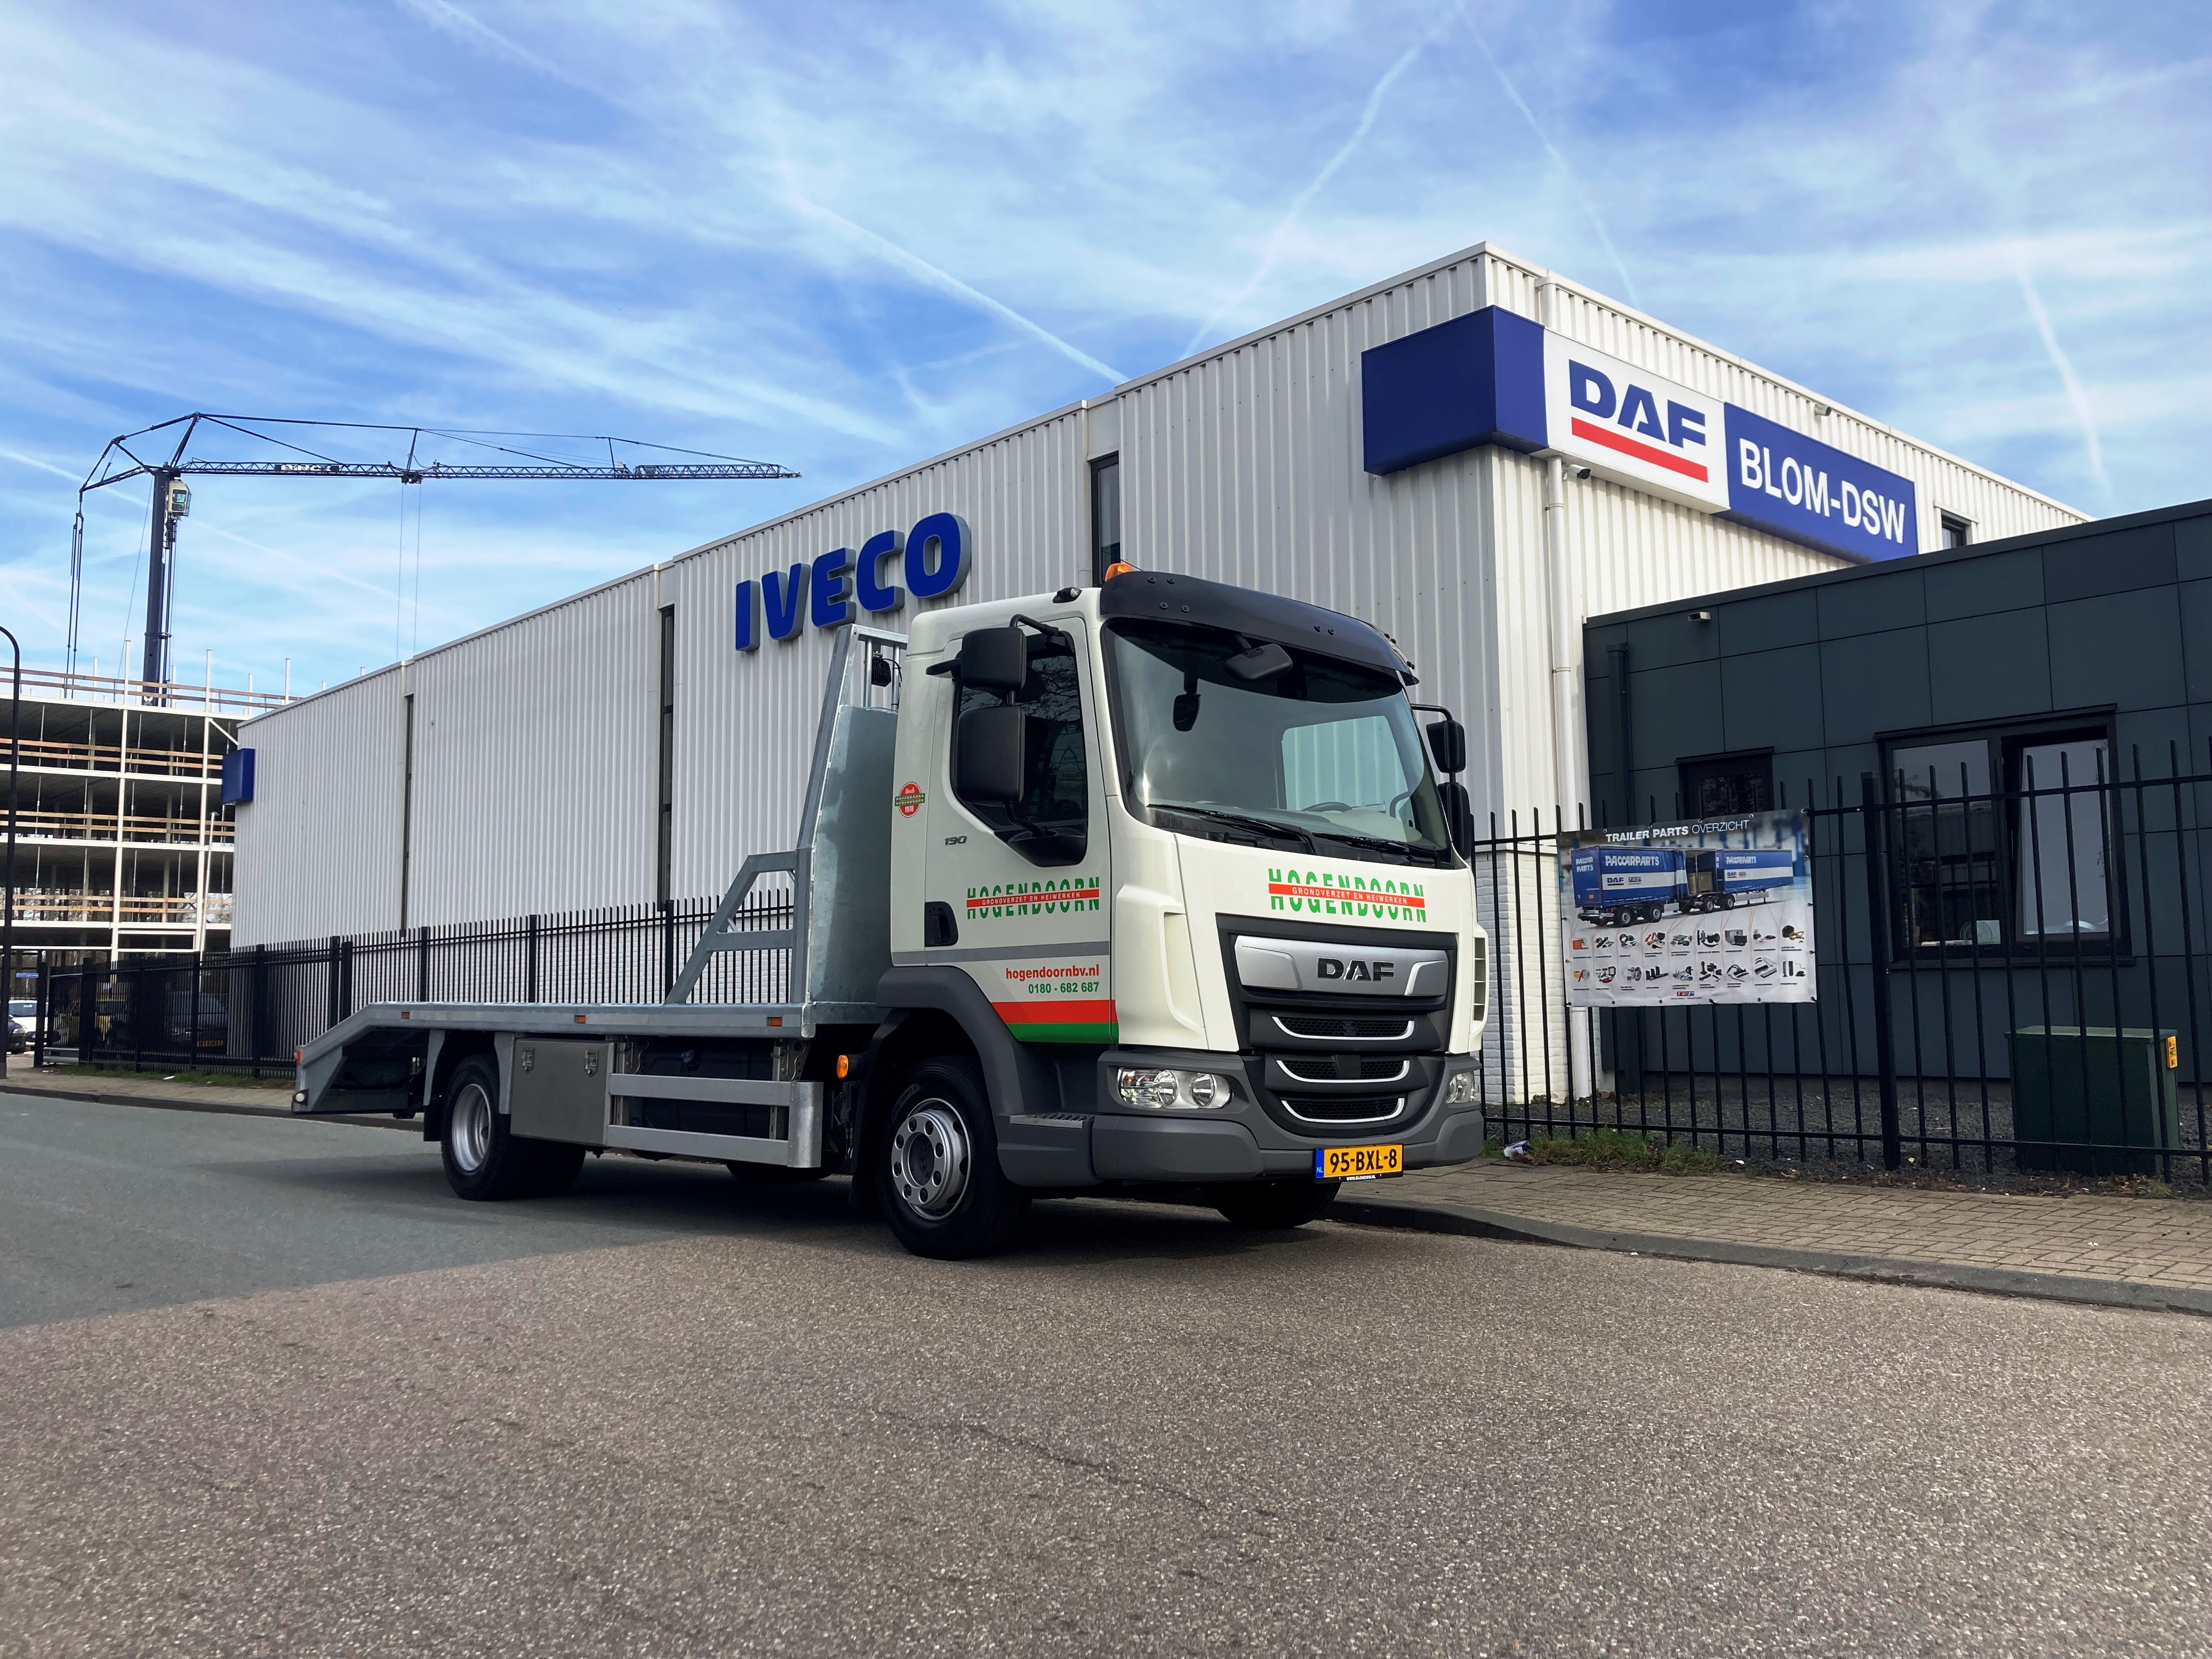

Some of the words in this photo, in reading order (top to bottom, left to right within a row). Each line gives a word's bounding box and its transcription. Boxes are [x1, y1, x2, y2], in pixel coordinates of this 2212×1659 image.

[1569, 359, 1706, 448] DAF
[1740, 438, 1905, 544] BLOM-DSW
[736, 512, 971, 651] IVECO
[945, 836, 968, 845] 190
[1606, 830, 1650, 843] TRAILER
[1652, 826, 1689, 838] PARTS
[1691, 820, 1750, 834] OVERZICHT
[1576, 864, 1594, 873] PARTS
[967, 877, 1099, 919] HOGENDOORN
[982, 896, 1027, 905] GRONDVERZET
[1041, 886, 1081, 900] HEIWERKEN
[1268, 868, 1426, 922] HOGENDOORN
[1292, 887, 1350, 900] GRONDVERZET
[1366, 894, 1407, 905] HEIWERKEN
[1006, 964, 1099, 981] hogendoornbv.nl
[1318, 957, 1394, 981] DAF
[1028, 983, 1051, 994] 0180
[1060, 983, 1078, 993] 682
[1081, 981, 1099, 992] 687
[1330, 1148, 1397, 1173] 95-BXL-8
